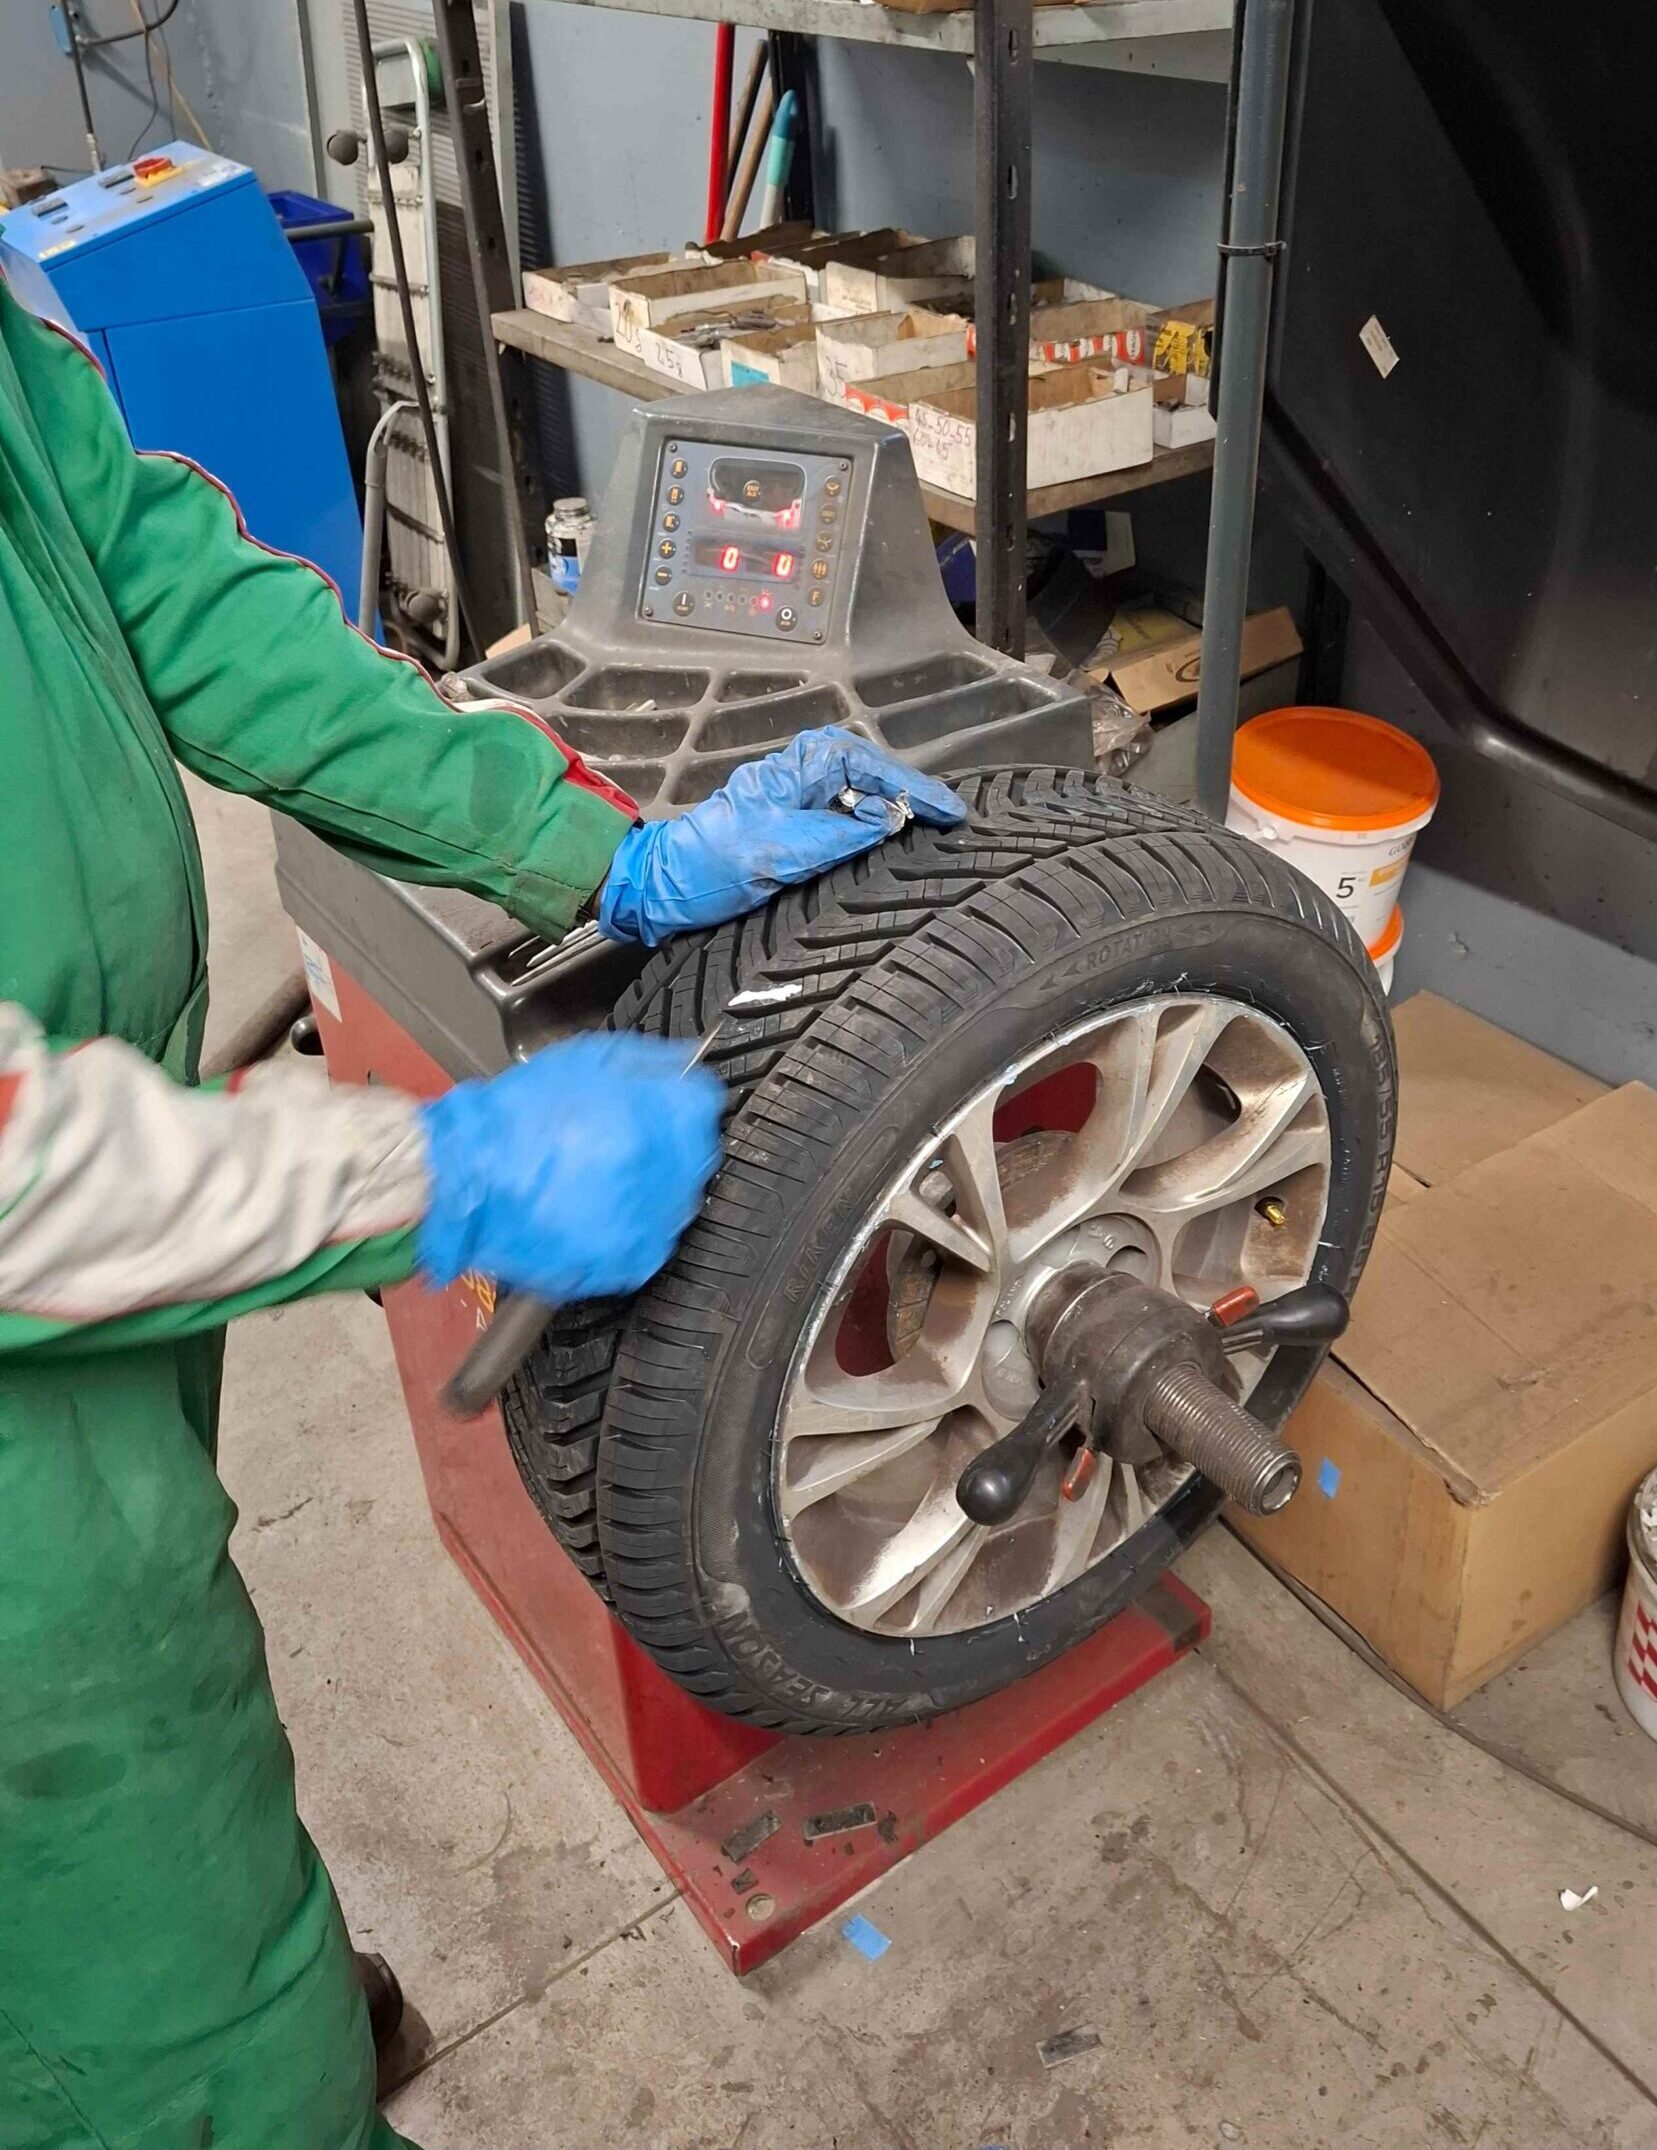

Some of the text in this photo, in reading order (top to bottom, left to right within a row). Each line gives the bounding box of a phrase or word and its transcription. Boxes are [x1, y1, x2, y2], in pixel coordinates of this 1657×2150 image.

[1335, 877, 1357, 899] 5
[1086, 925, 1173, 971] ROTATION
[716, 1609, 834, 1704] SEASON
